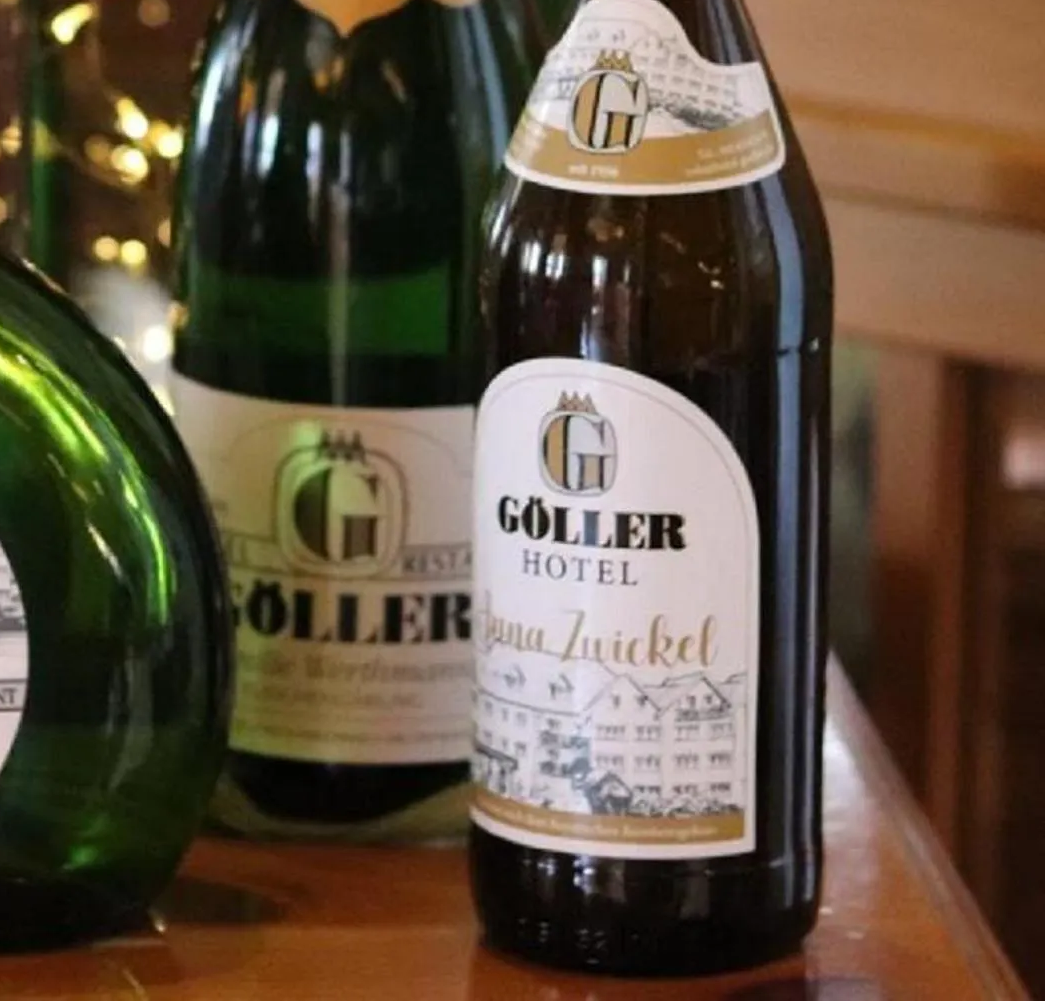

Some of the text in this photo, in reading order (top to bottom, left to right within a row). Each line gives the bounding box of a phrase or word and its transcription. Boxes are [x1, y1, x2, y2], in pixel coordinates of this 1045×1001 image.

[497, 494, 688, 552] GÖLLER
[521, 548, 640, 588] HOTEL
[559, 607, 720, 669] Zwickel
